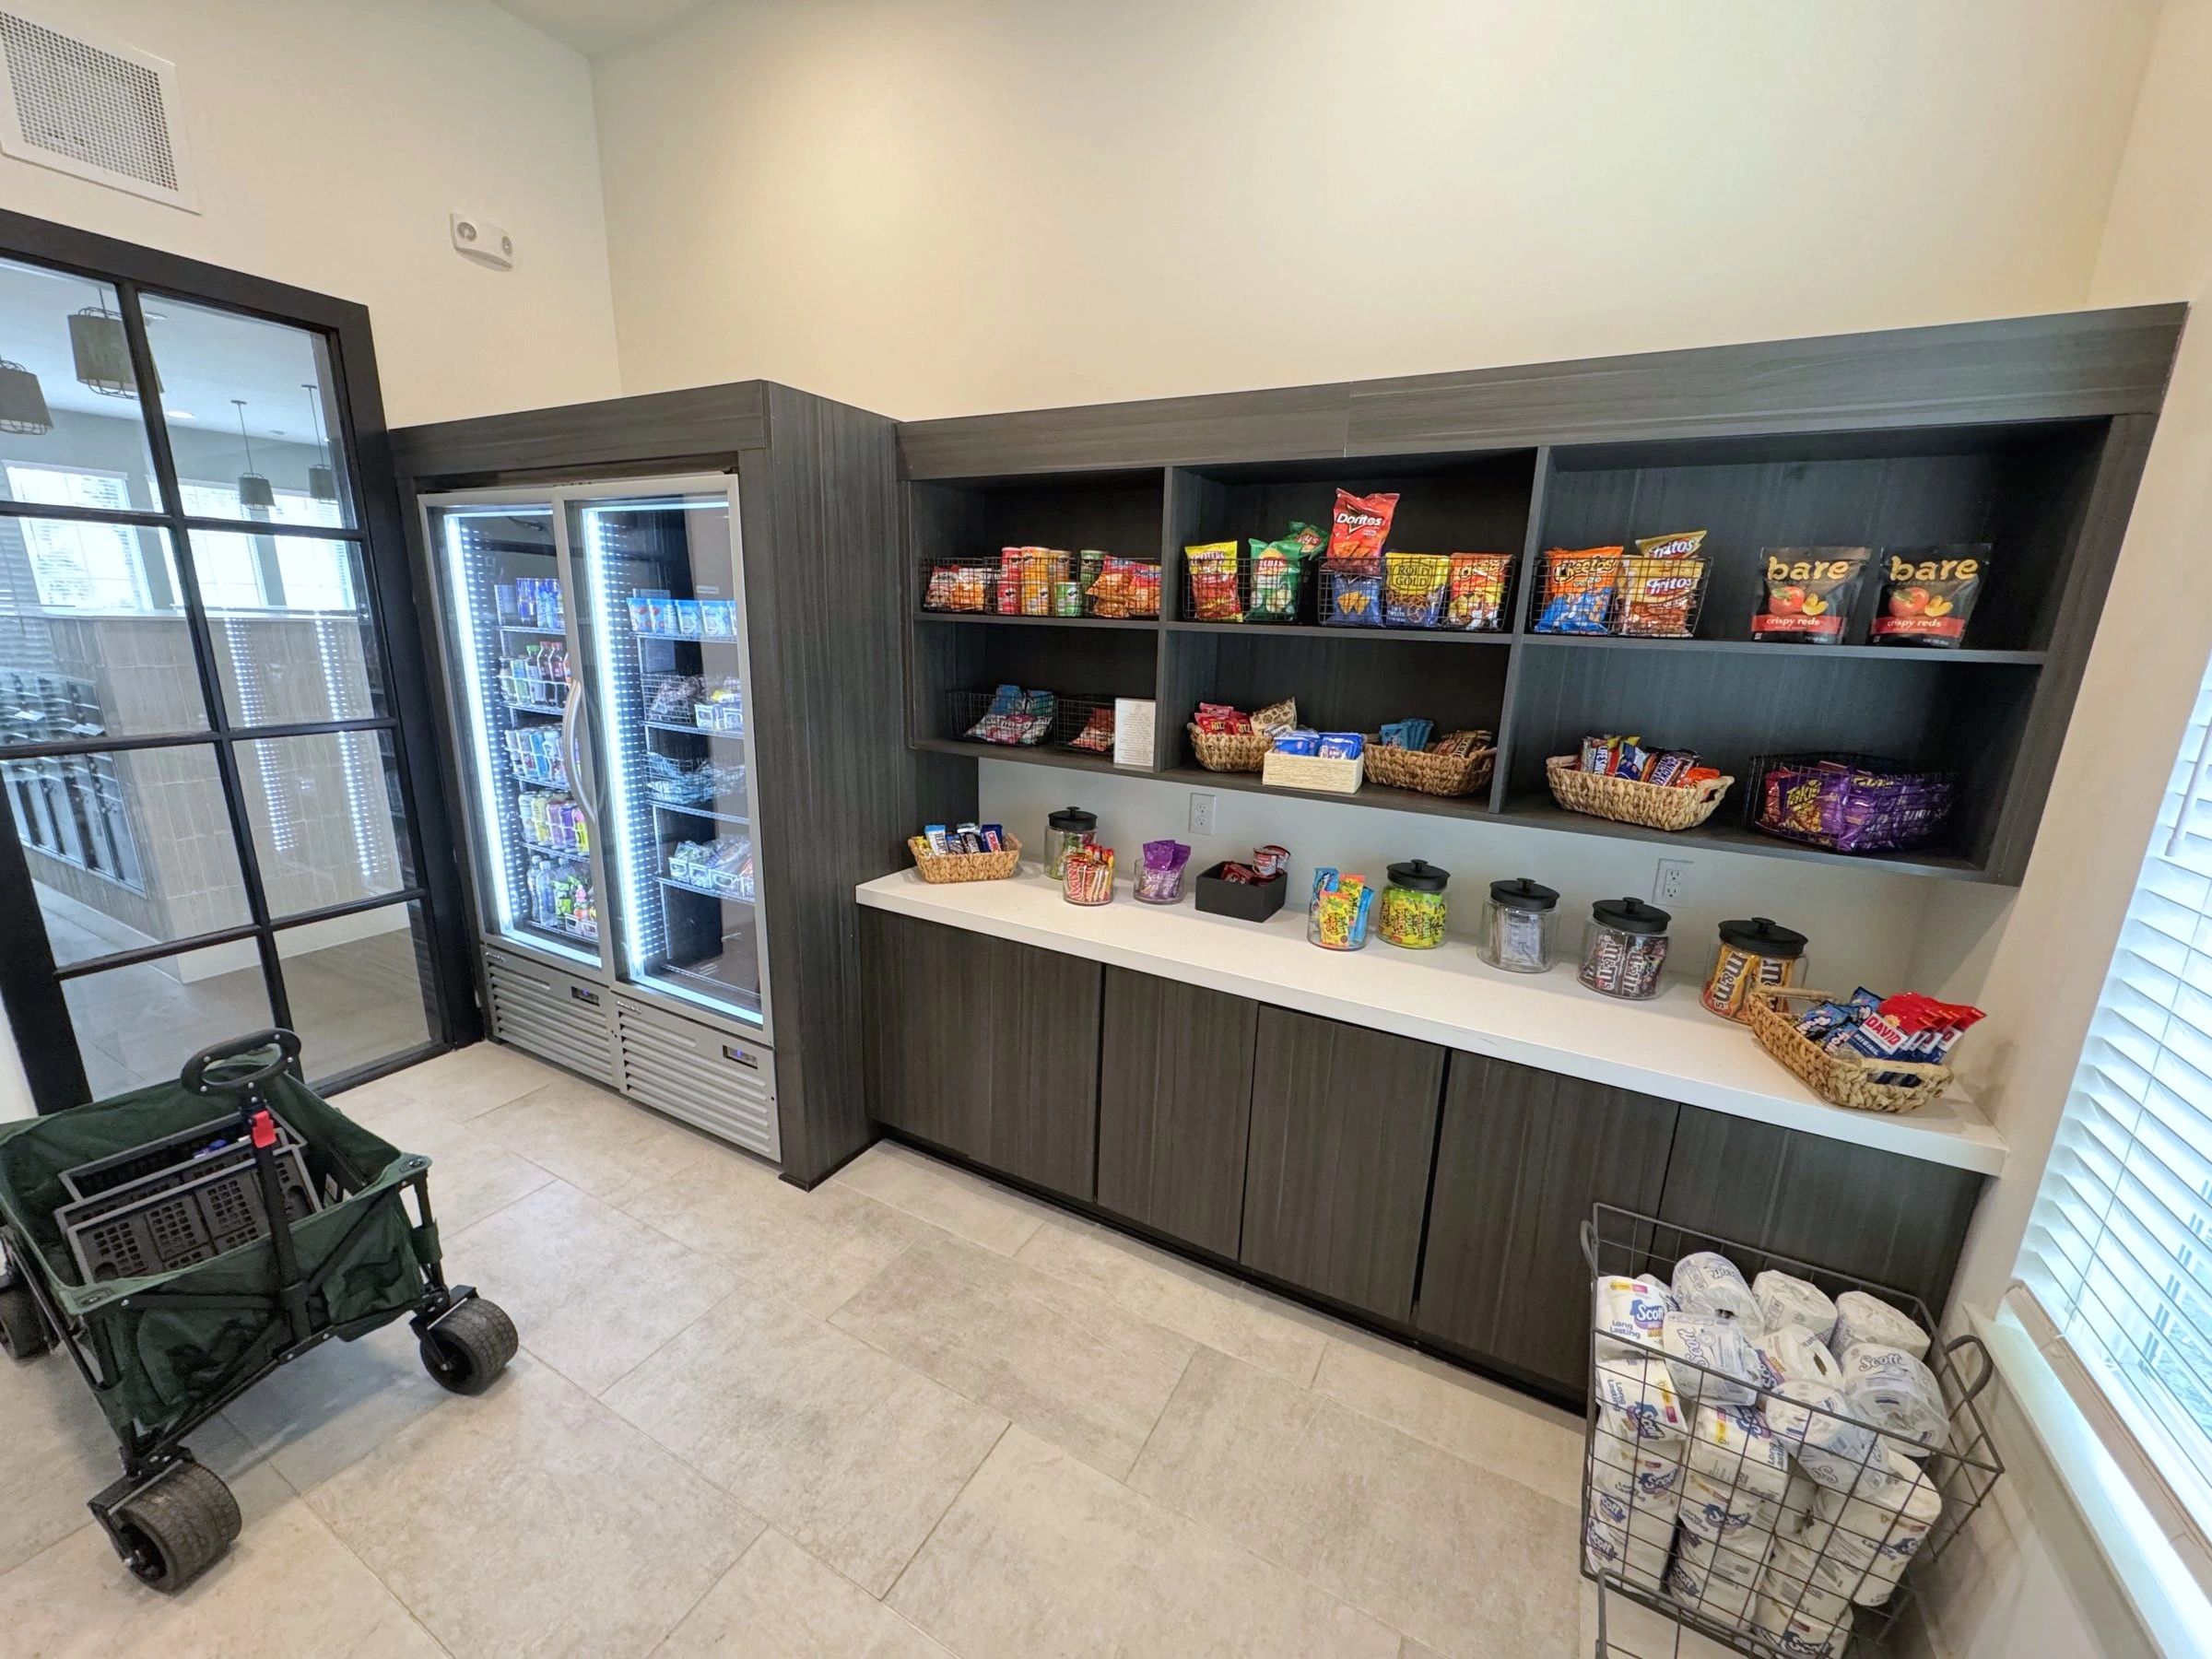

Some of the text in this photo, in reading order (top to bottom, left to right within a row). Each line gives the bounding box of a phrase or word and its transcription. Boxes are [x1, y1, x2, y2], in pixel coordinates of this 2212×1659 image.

[1336, 512, 1383, 526] Doritos
[1650, 538, 1696, 559] Fritos
[1397, 565, 1430, 576] ROLD
[1554, 557, 1616, 582] Cheetos
[1767, 555, 1849, 581] bare
[1889, 555, 1979, 582] bare
[1395, 576, 1429, 587] GOLD
[1646, 577, 1692, 595] Fritos
[1767, 617, 1820, 627] crispy reds
[1887, 618, 1942, 629] crispy reds
[1210, 721, 1227, 731] RITZ
[1336, 913, 1347, 935] SOUR
[1865, 1016, 1902, 1046] DAVID
[1853, 1032, 1879, 1056] ORIGINAL
[1609, 1325, 1641, 1340] Lasting
[1611, 1319, 1634, 1331] Long
[1677, 1327, 1710, 1368] Scott
[1858, 1353, 1904, 1372] Scott
[1615, 1381, 1627, 1406] Long
[1767, 1441, 1777, 1465] Long
